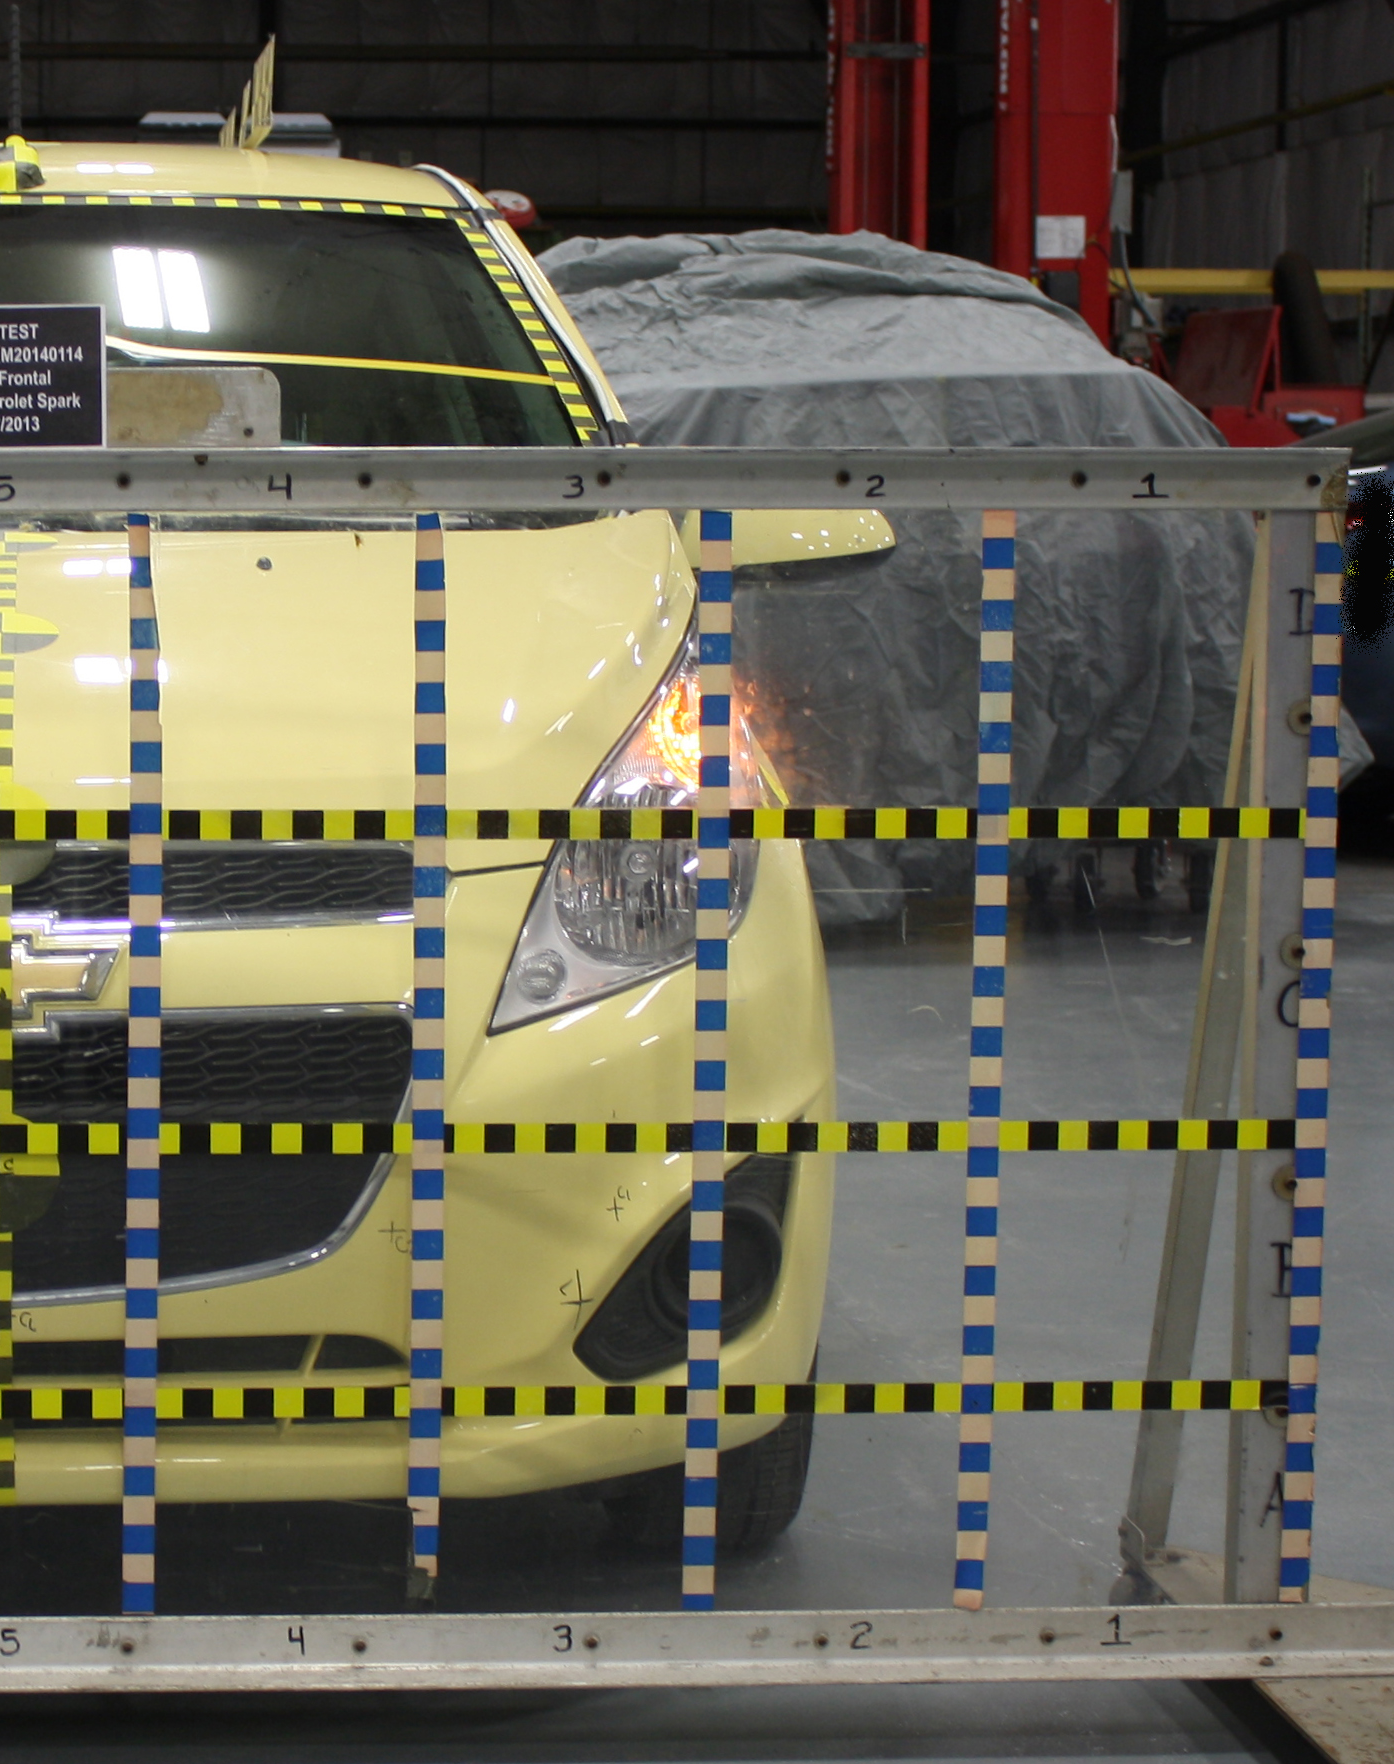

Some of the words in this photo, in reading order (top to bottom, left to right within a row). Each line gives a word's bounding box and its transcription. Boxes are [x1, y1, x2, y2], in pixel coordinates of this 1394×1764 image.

[0, 369, 52, 386] Frontal
[37, 392, 81, 412] Spark
[268, 473, 291, 499] 4
[563, 475, 584, 498] 3
[866, 475, 885, 498] 2
[1133, 472, 1168, 499] 1
[0, 1629, 20, 1655] 5
[288, 1626, 305, 1655] 4
[553, 1625, 573, 1651] 3
[850, 1621, 873, 1649] 2
[1101, 1614, 1132, 1646] 1
